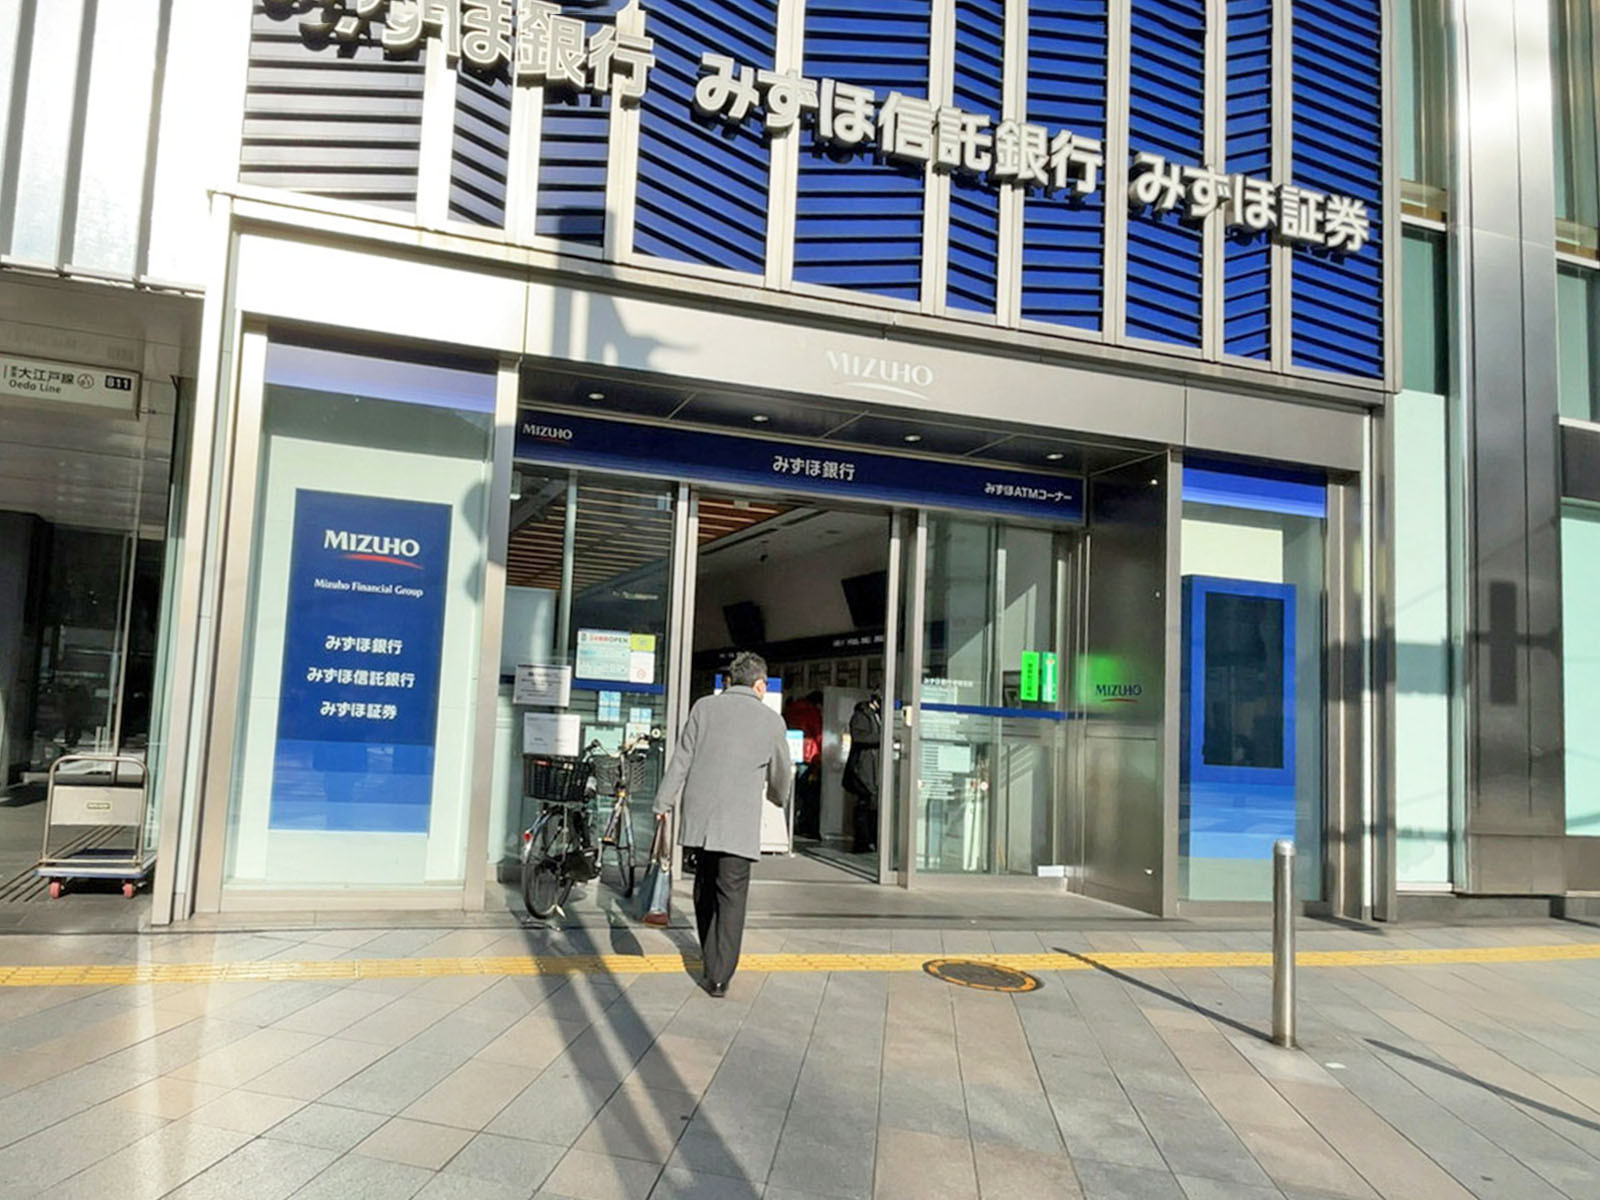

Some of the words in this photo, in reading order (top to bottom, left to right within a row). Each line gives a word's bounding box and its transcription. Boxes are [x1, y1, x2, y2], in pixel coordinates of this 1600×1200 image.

[694, 52, 1103, 195] みずほ信託銀行
[1130, 150, 1370, 251] みずほ証券
[825, 350, 934, 387] MIZUHO
[8, 379, 37, 391] Oedo
[39, 383, 62, 394] Line
[523, 423, 573, 440] MIZUHO
[772, 455, 856, 481] みずほ銀行
[984, 483, 1072, 501] みずほATMコーナー
[323, 529, 421, 557] MIZUHO
[314, 578, 350, 591] Mizuho
[351, 581, 393, 594] Financial
[394, 585, 424, 599] Group
[325, 635, 403, 655] みずほ銀行
[307, 667, 415, 687] みずほ信託銀行
[1095, 683, 1143, 697] MIZUHO
[320, 701, 397, 720] みずほ証券
